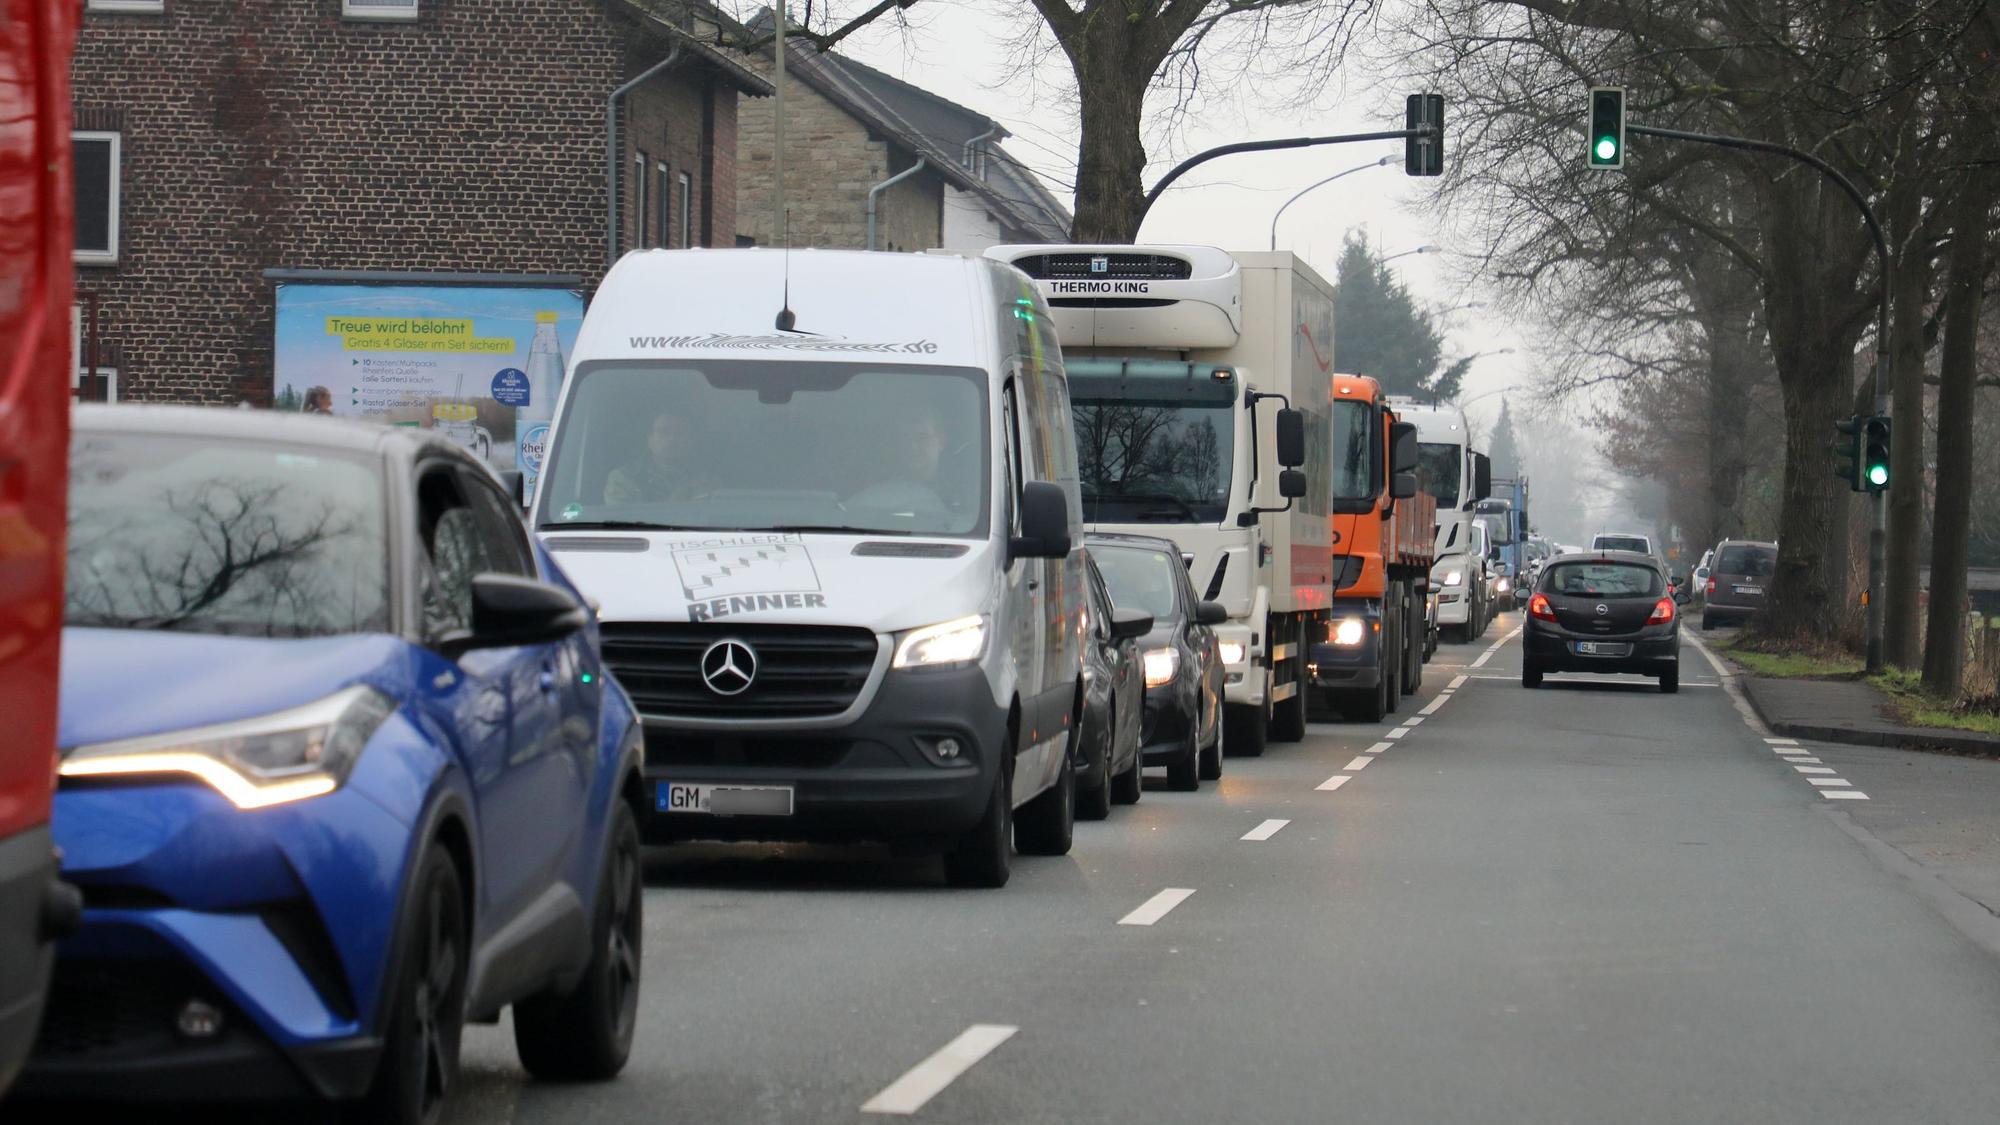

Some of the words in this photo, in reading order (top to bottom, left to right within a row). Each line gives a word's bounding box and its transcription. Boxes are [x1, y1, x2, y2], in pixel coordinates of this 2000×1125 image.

[1051, 281, 1111, 293] THERMO
[1114, 282, 1149, 293] KING
[332, 319, 371, 332] Treue
[376, 320, 407, 333] wird
[412, 321, 465, 334] belohnt
[349, 337, 381, 348] Gratis
[384, 338, 390, 346] 4
[431, 340, 445, 349] im
[448, 339, 466, 350] Set
[469, 340, 510, 351] sichern!
[687, 593, 828, 622] RENNER
[670, 787, 699, 808] GM
